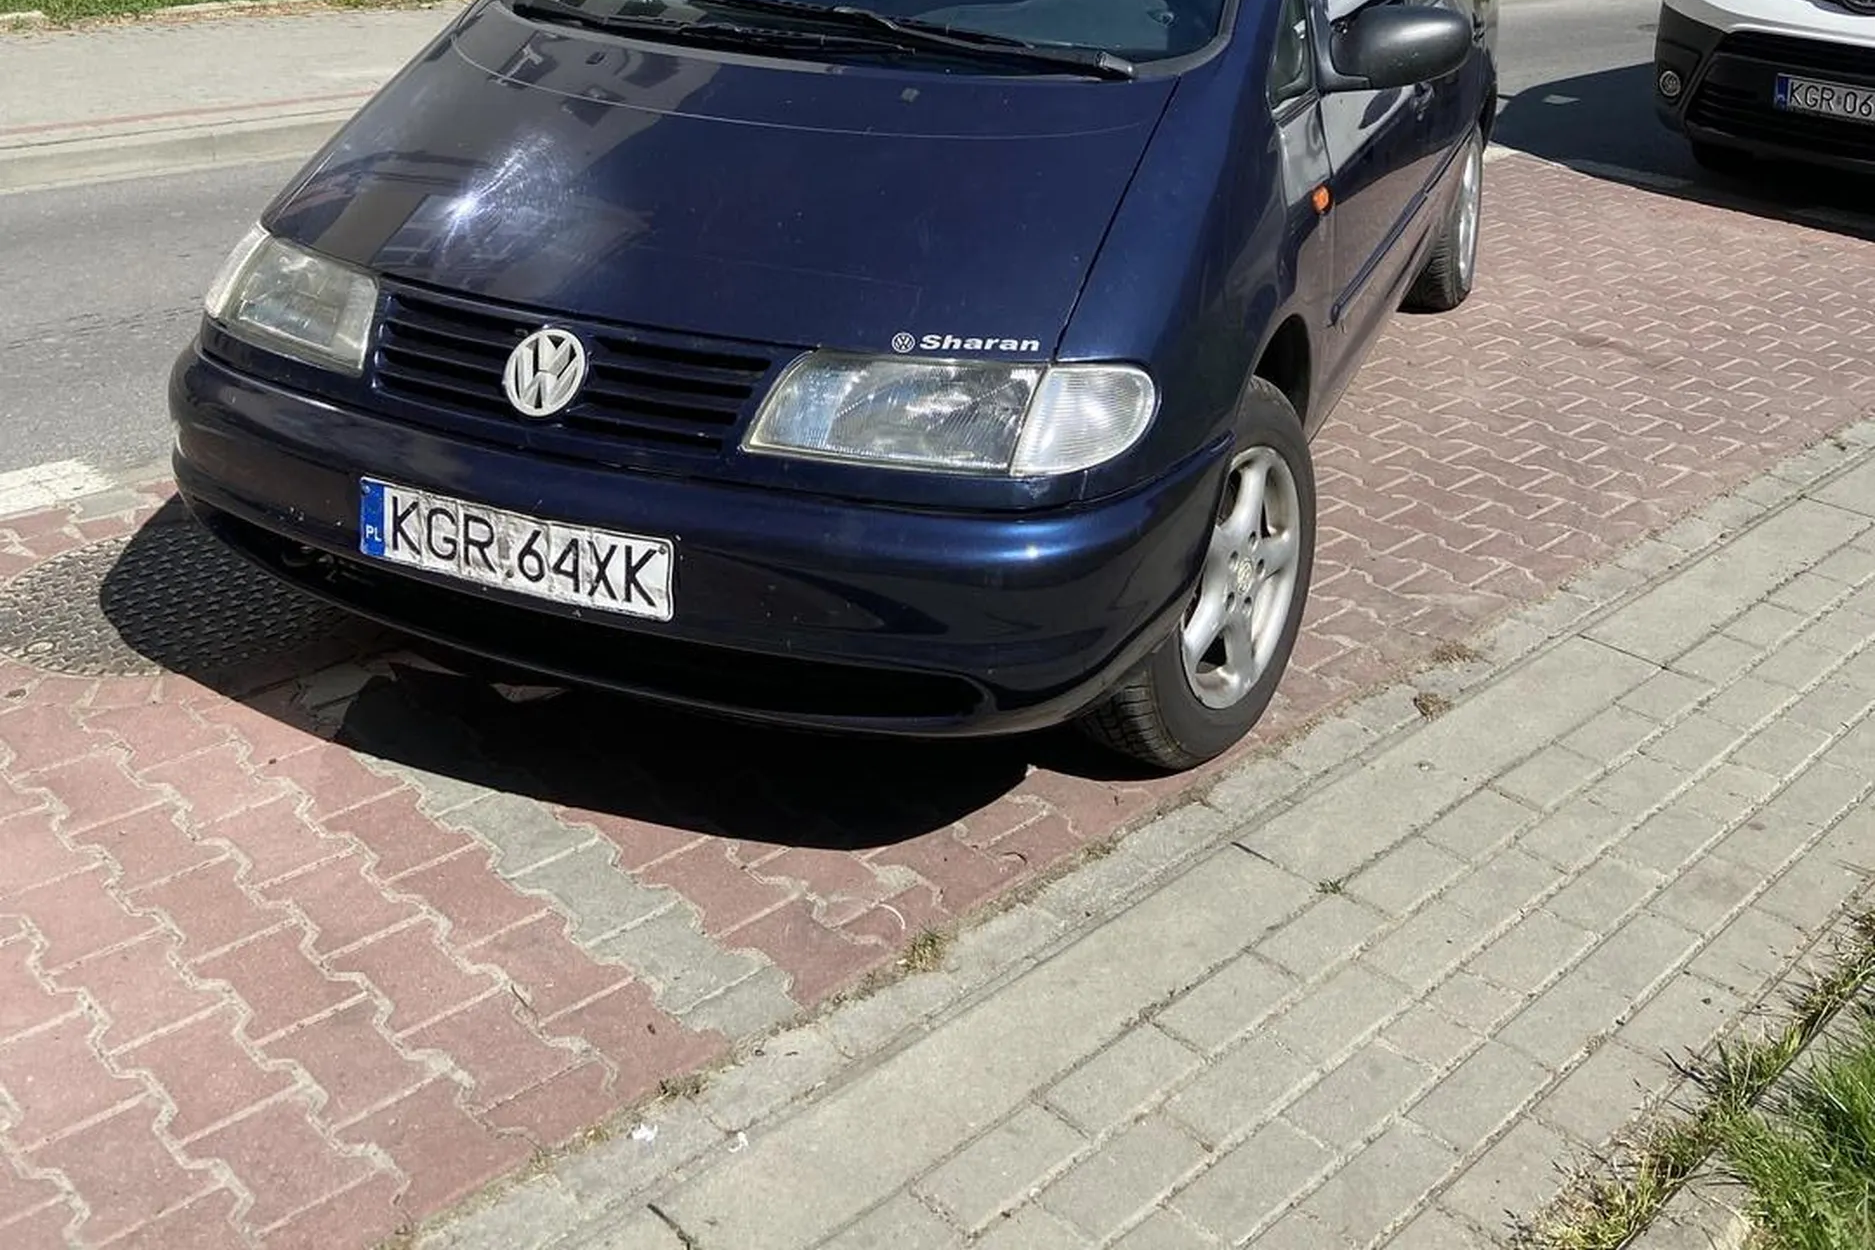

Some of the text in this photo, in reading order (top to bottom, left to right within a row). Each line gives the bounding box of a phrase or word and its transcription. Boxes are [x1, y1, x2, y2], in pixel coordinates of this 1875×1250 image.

[1789, 82, 1836, 111] KGR
[919, 334, 1041, 352] Sharan
[365, 524, 383, 543] PL
[391, 496, 658, 607] KGR 64XK
